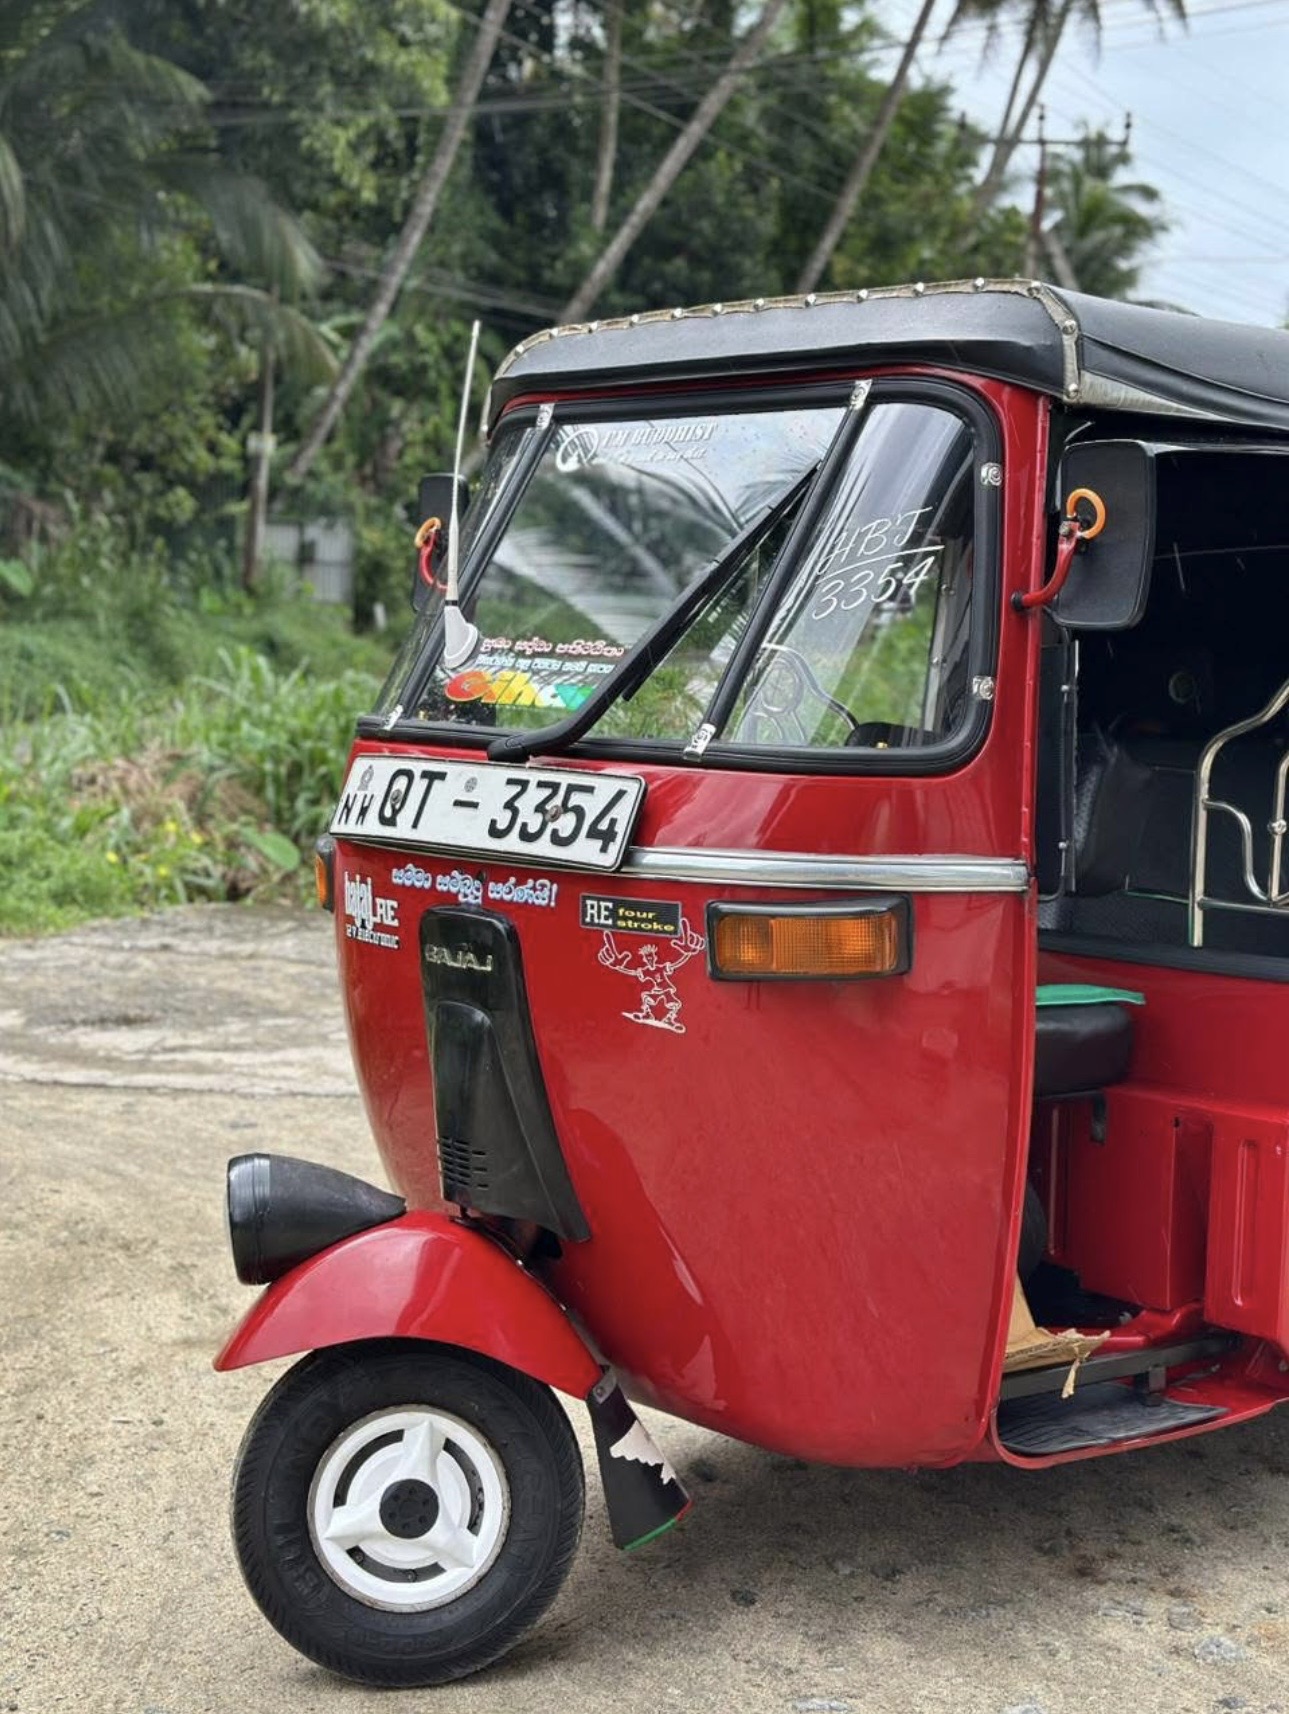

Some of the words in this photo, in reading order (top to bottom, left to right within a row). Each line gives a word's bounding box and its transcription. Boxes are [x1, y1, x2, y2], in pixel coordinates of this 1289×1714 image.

[812, 556, 935, 620] 3354
[378, 768, 447, 829] QT
[488, 777, 628, 853] 3354
[584, 899, 614, 925] RE
[618, 908, 657, 919] four
[616, 919, 676, 932] stroke
[425, 943, 493, 972] BAJAJ
